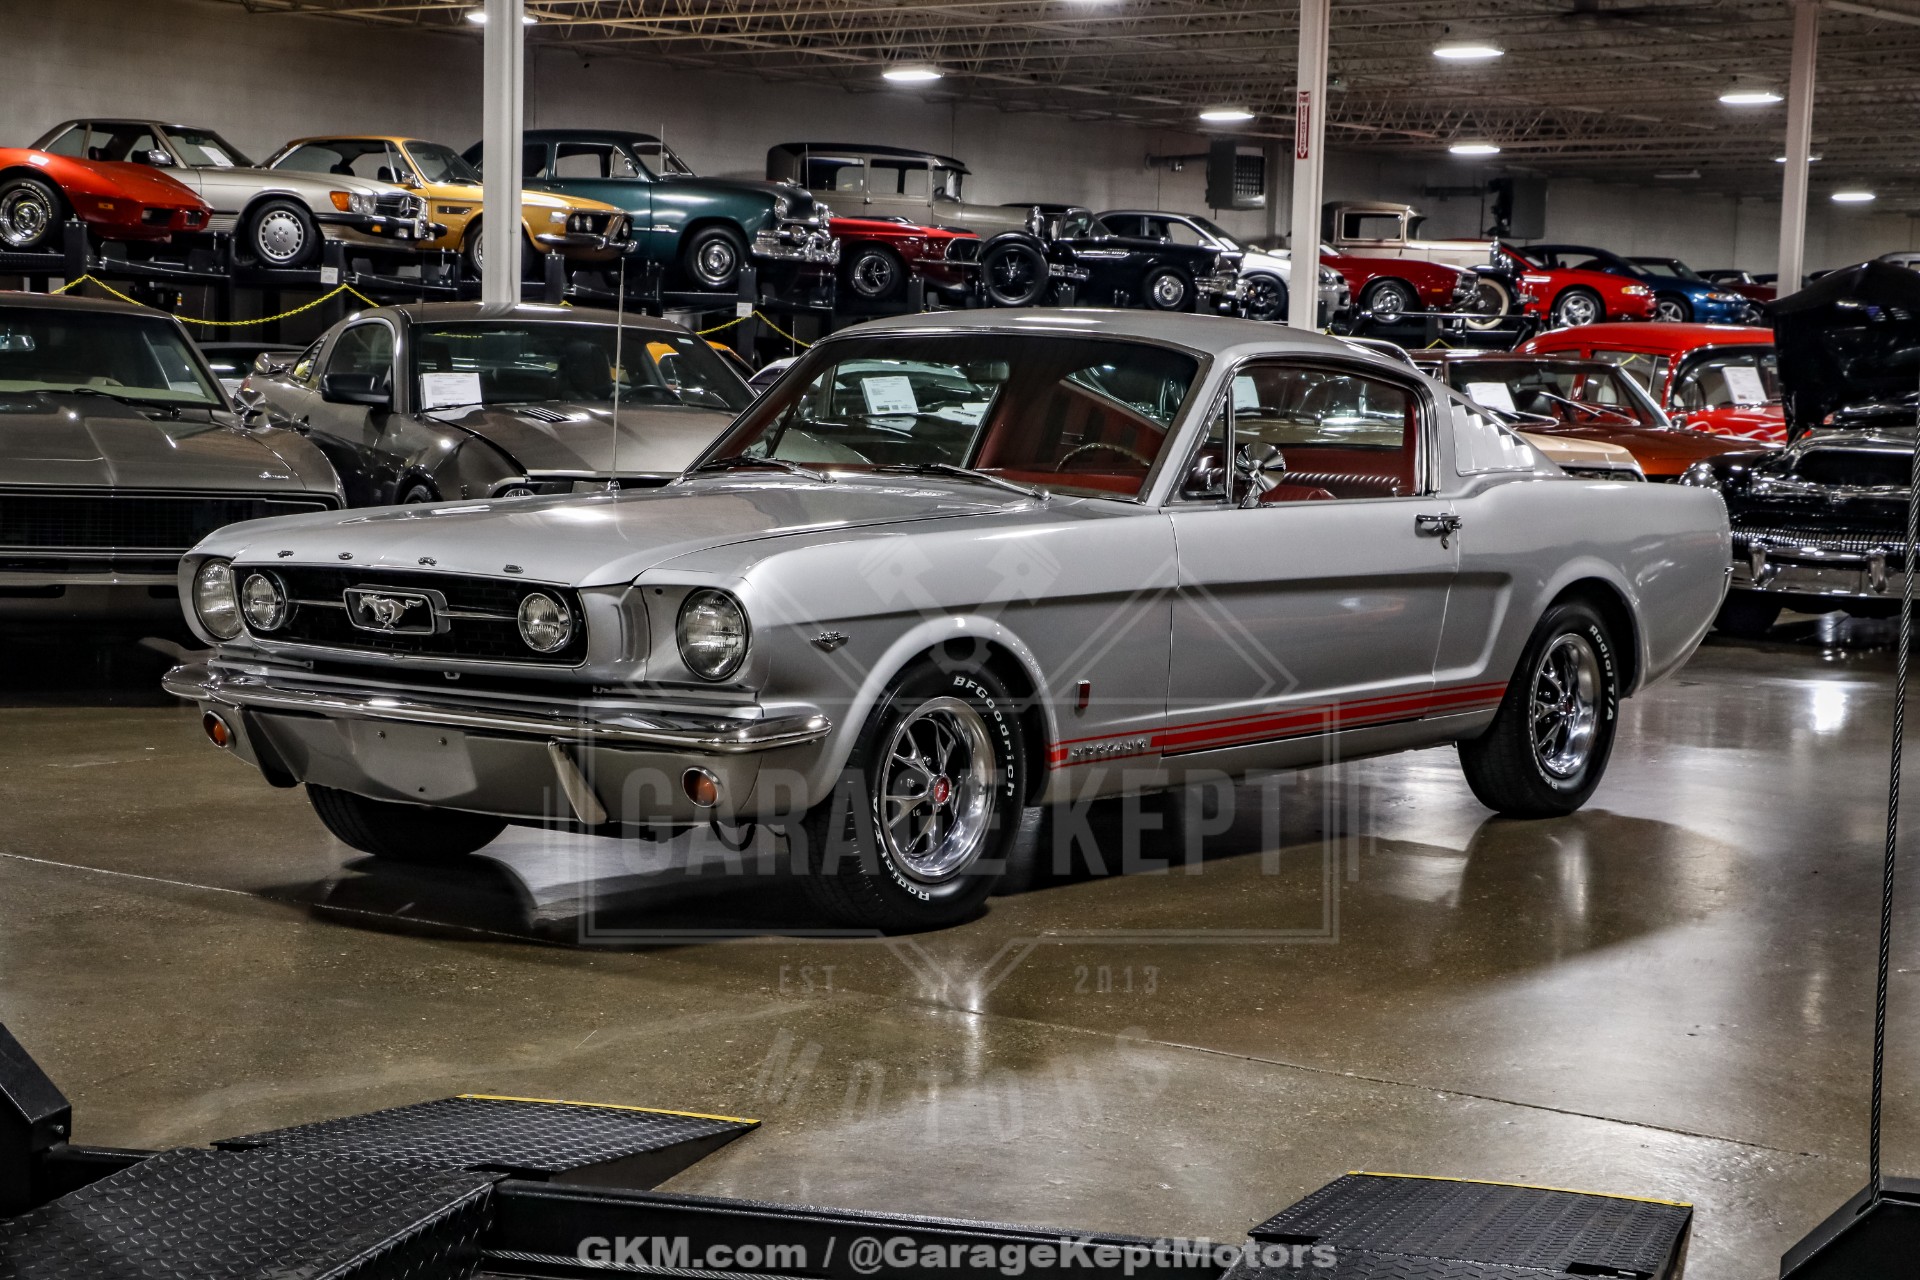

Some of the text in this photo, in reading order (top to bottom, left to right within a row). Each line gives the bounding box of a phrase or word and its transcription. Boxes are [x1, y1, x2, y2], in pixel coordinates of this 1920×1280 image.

[1589, 625, 1615, 720] Radial T/A
[954, 676, 1014, 797] BFGoodrich
[872, 796, 930, 901] Radial T/A
